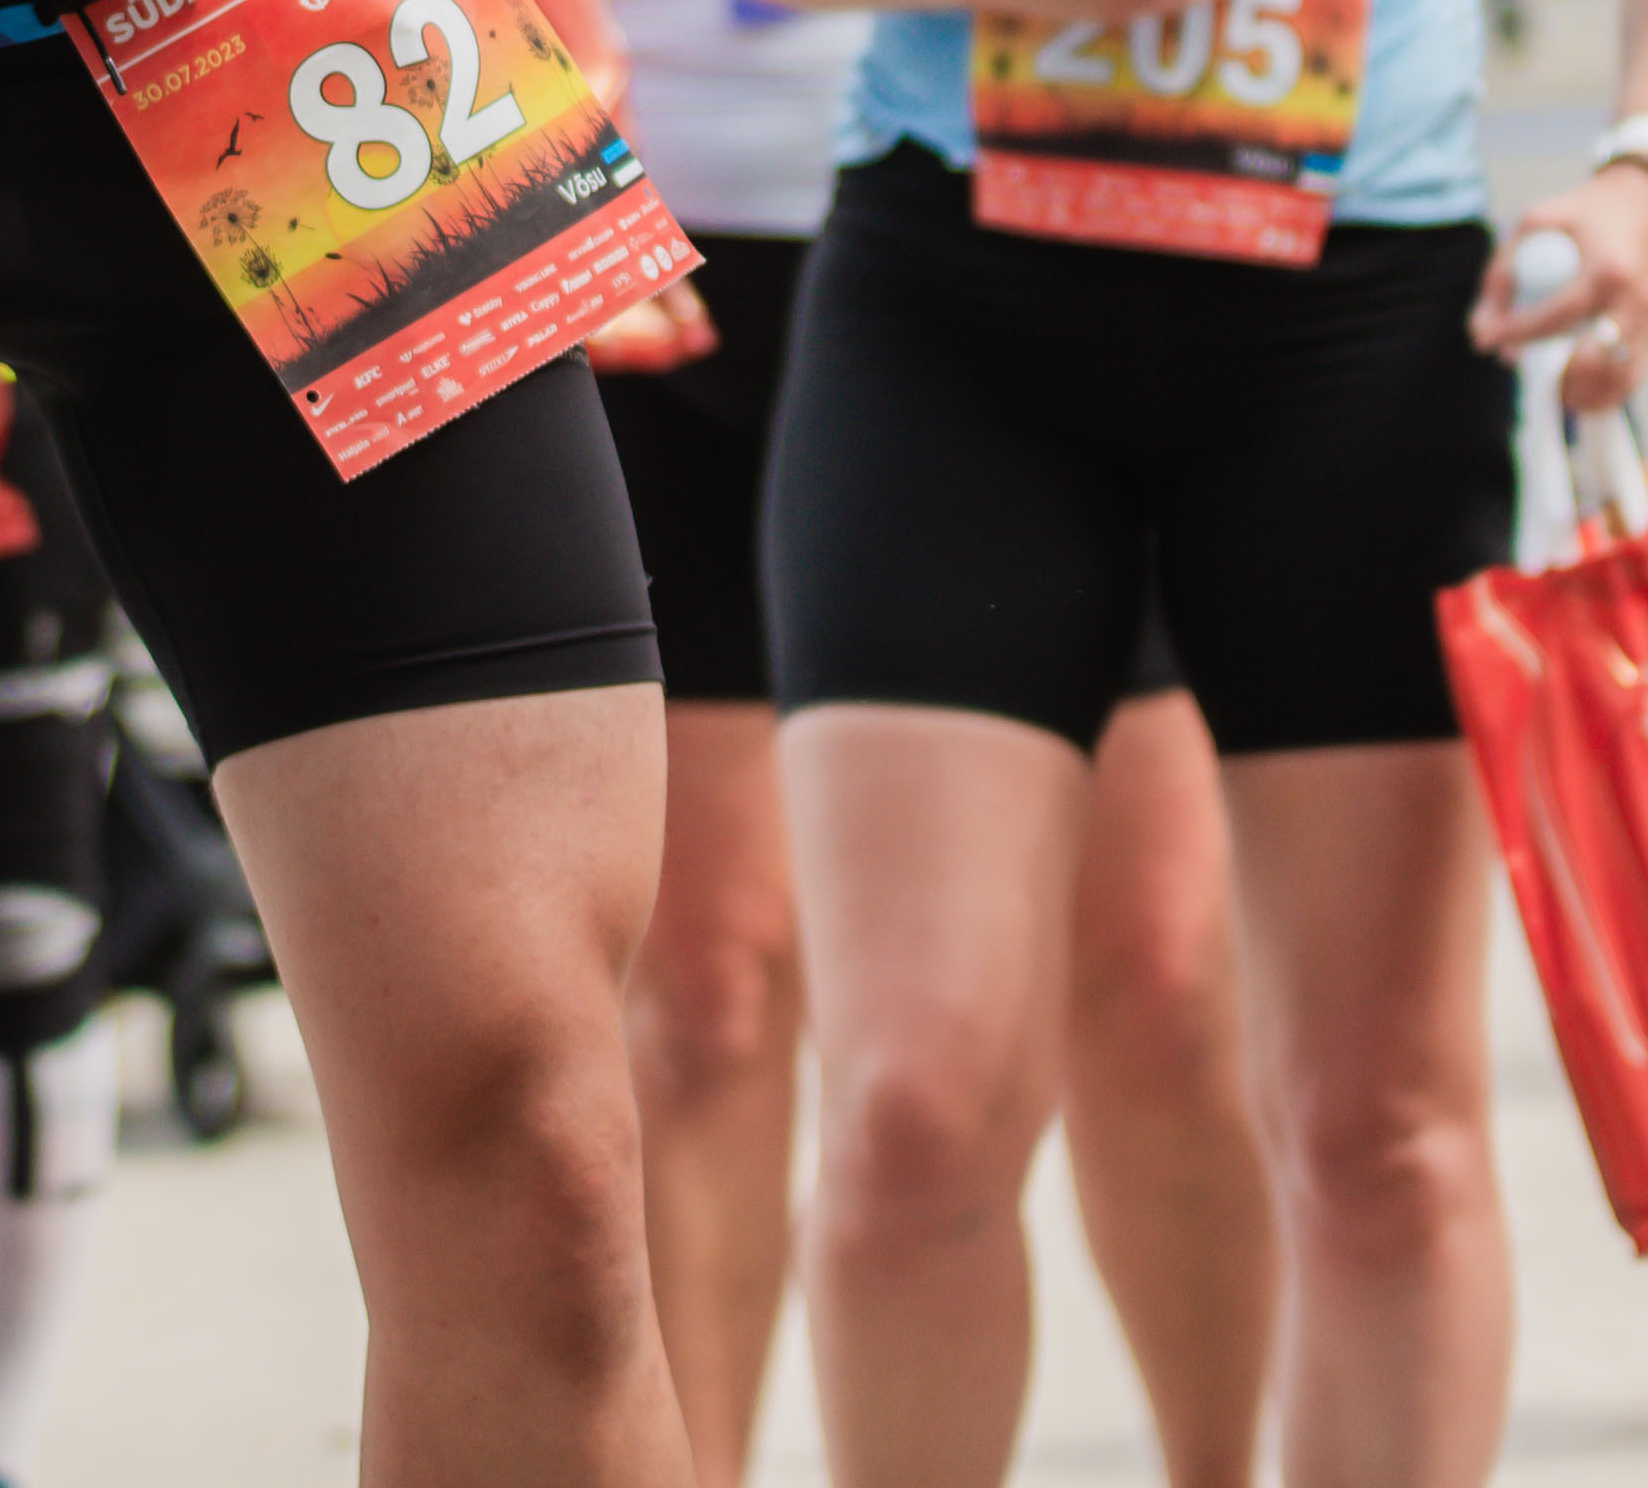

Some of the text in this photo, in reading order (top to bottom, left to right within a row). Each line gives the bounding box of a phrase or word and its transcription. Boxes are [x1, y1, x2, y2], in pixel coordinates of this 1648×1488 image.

[132, 33, 247, 111] 30.07.2023
[556, 166, 608, 206] Võsu
[353, 365, 383, 390] KFC
